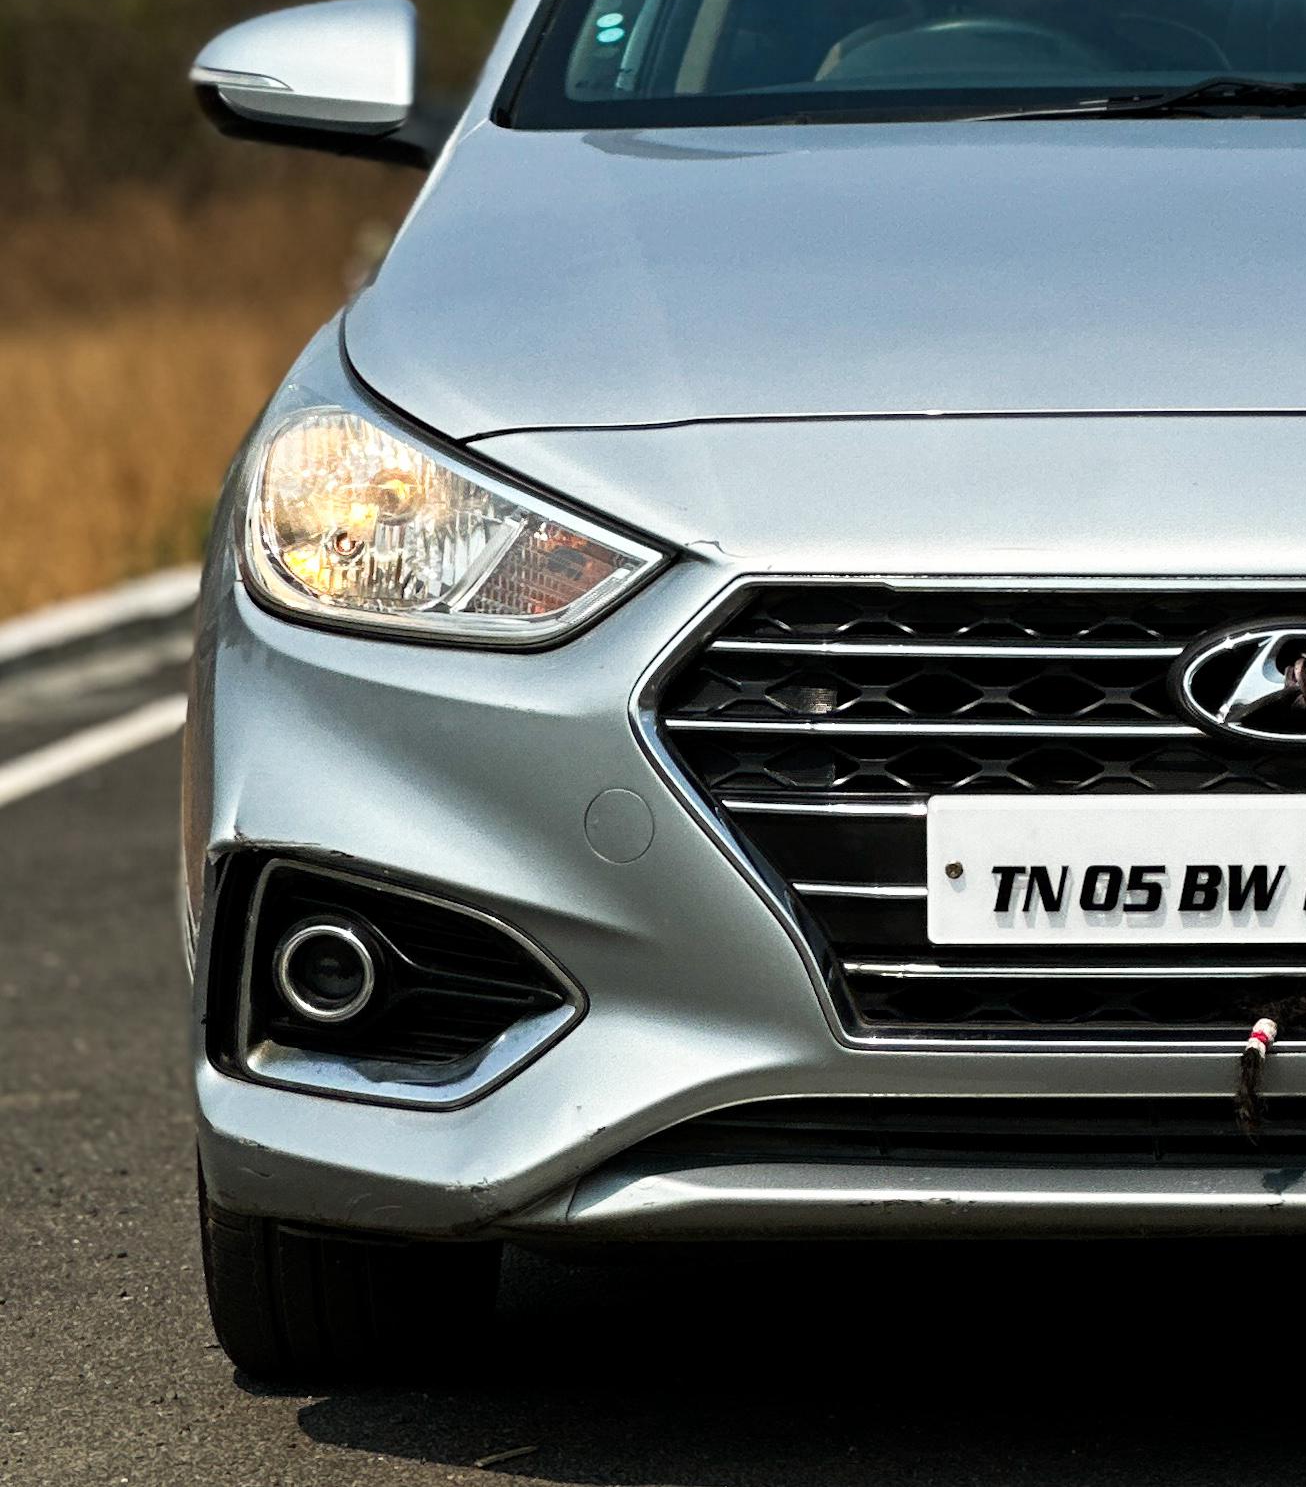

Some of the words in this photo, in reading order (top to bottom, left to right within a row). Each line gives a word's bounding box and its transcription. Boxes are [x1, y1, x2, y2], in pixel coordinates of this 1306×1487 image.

[992, 865, 1069, 912] TN
[1079, 865, 1166, 912] 05
[1177, 865, 1287, 912] BW
